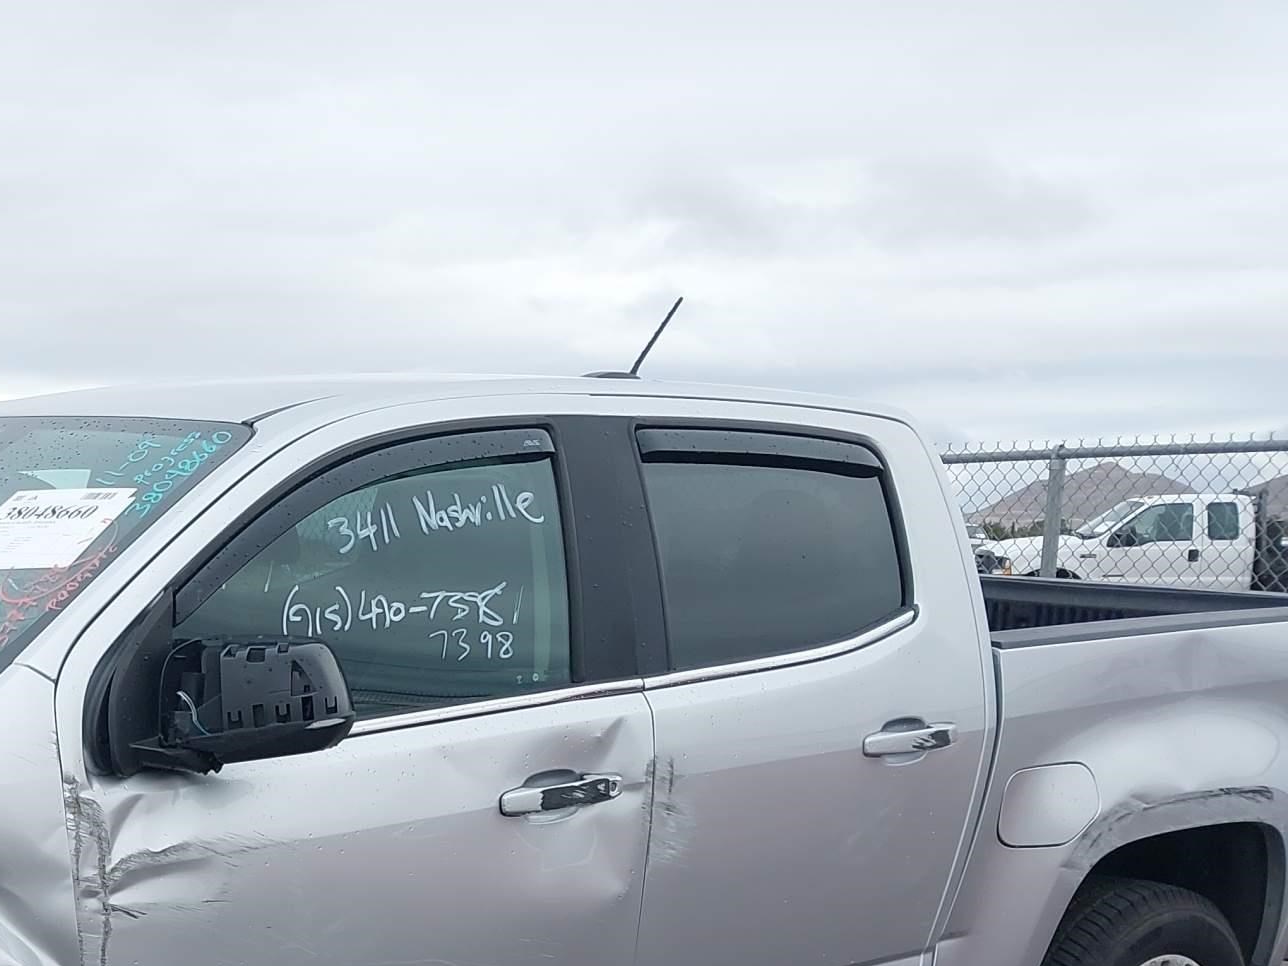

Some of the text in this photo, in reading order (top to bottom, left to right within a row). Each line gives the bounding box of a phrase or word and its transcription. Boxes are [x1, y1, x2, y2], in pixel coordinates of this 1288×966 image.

[327, 483, 545, 554] 3411 Nashville
[429, 628, 514, 661] 7398
